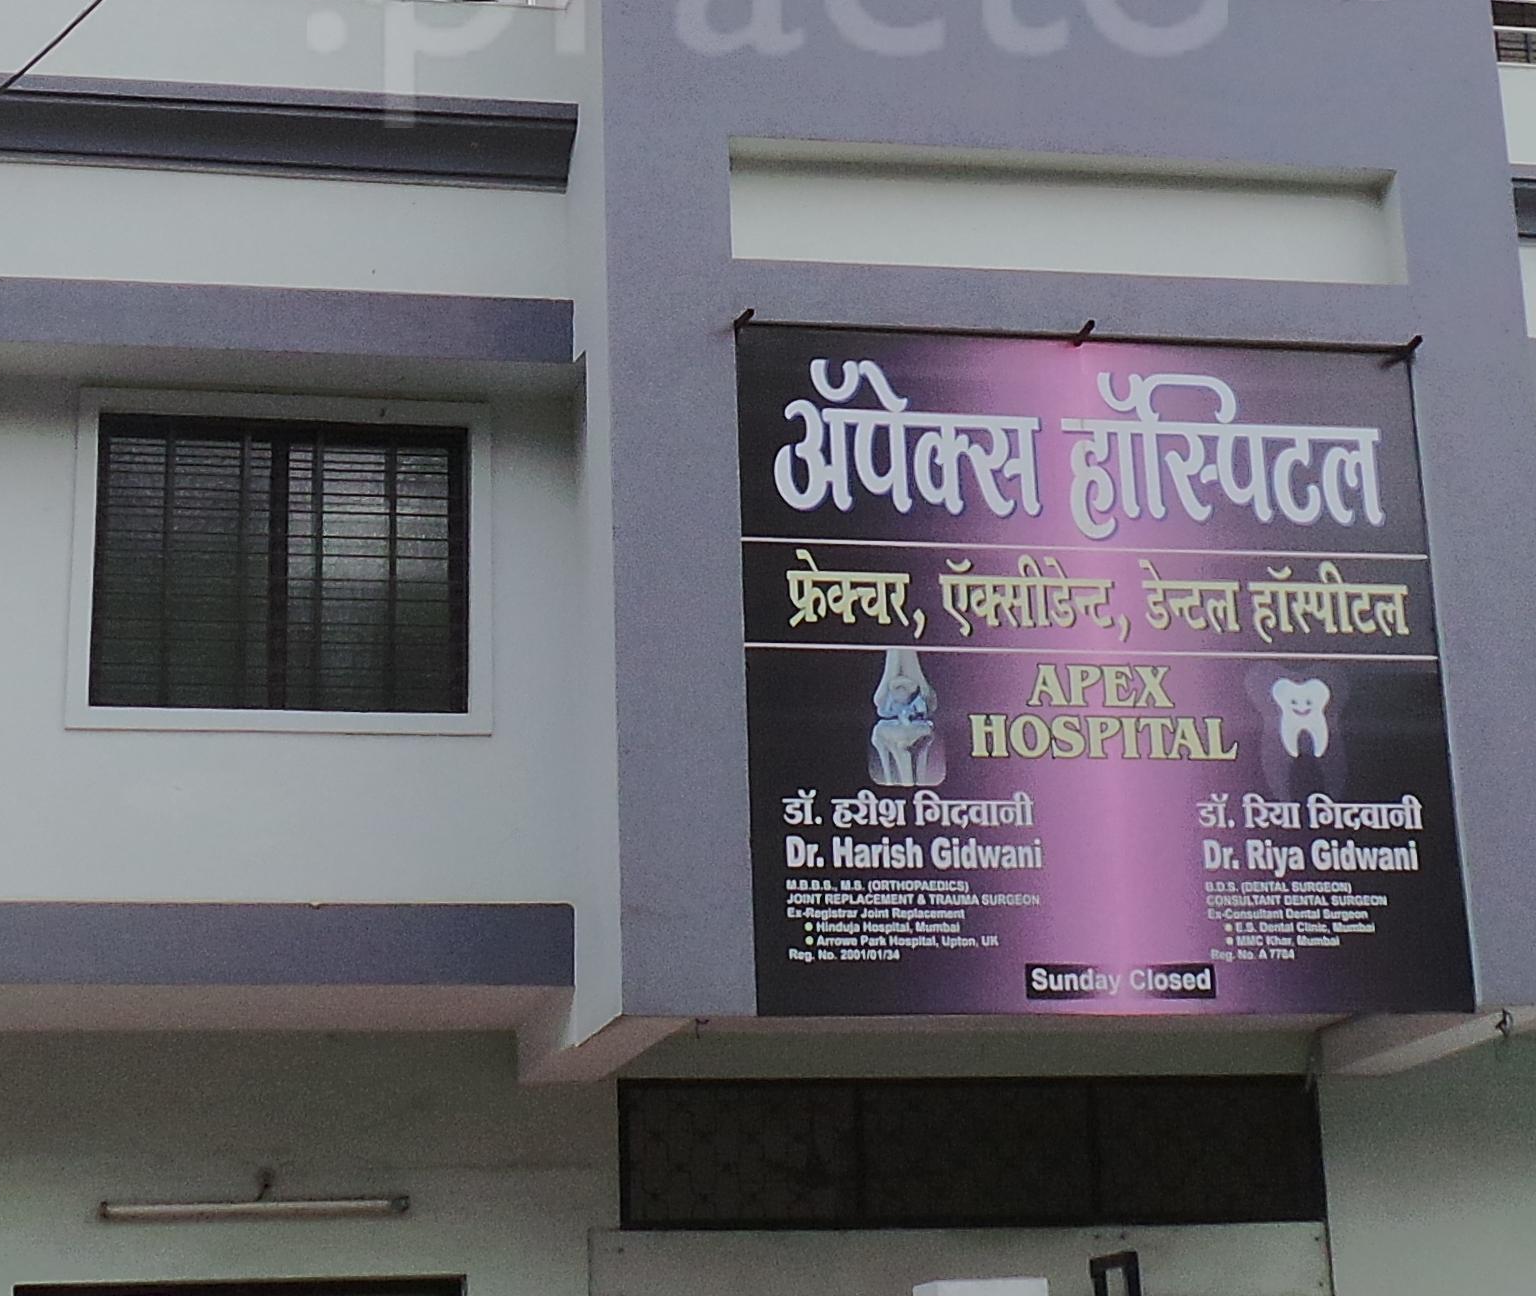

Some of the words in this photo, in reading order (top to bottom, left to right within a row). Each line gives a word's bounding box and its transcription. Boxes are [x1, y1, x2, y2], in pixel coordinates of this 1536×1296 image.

[1061, 371, 1385, 540] हॉस्पिटल
[1139, 559, 1241, 634] डेन्टल
[1248, 561, 1411, 644] हॉस्पीटल
[1026, 662, 1175, 708] APEX
[968, 713, 1239, 761] HOSPITAL
[782, 789, 822, 826] डॉ.
[831, 789, 907, 828] हरीश
[913, 789, 1035, 829] गिदवानी
[1196, 793, 1235, 829] डॉ.
[1242, 793, 1301, 829] रिया
[1307, 793, 1423, 831] गिदवानी
[785, 835, 825, 868] Dr.
[832, 835, 924, 869] Harish
[931, 836, 1043, 870] Gidwani
[1203, 839, 1240, 870] Dr.
[1246, 839, 1305, 878] Riya
[1311, 839, 1419, 871] Gidwani
[868, 880, 969, 893] (ORTHOPAEDICS)
[1241, 881, 1290, 893] (DENTAL
[1291, 881, 1352, 894] SURGEON)
[786, 893, 822, 905] JOINT
[824, 893, 914, 905] REPLACEMENT
[917, 893, 926, 905] &
[928, 893, 980, 906] TRAUMA
[981, 894, 1040, 906] SURGEON
[1206, 895, 1281, 906] CONSULTANT
[1284, 895, 1327, 906] DENTAL
[1331, 895, 1388, 906] SURGEON
[787, 907, 858, 920] Ex-Registrar
[861, 907, 890, 919] Joint
[892, 907, 965, 921] Replacement
[1285, 908, 1321, 919] Dental
[1323, 909, 1369, 921] Surgeon
[816, 921, 861, 934] Hinduja
[915, 922, 961, 933] Mumbai
[1259, 922, 1294, 933] Dental
[861, 935, 887, 946] Park
[981, 936, 999, 947] UK
[789, 949, 816, 962] Reg.
[818, 949, 837, 960] No.
[1031, 967, 1121, 995] Sunday
[1129, 968, 1211, 991] Closed
